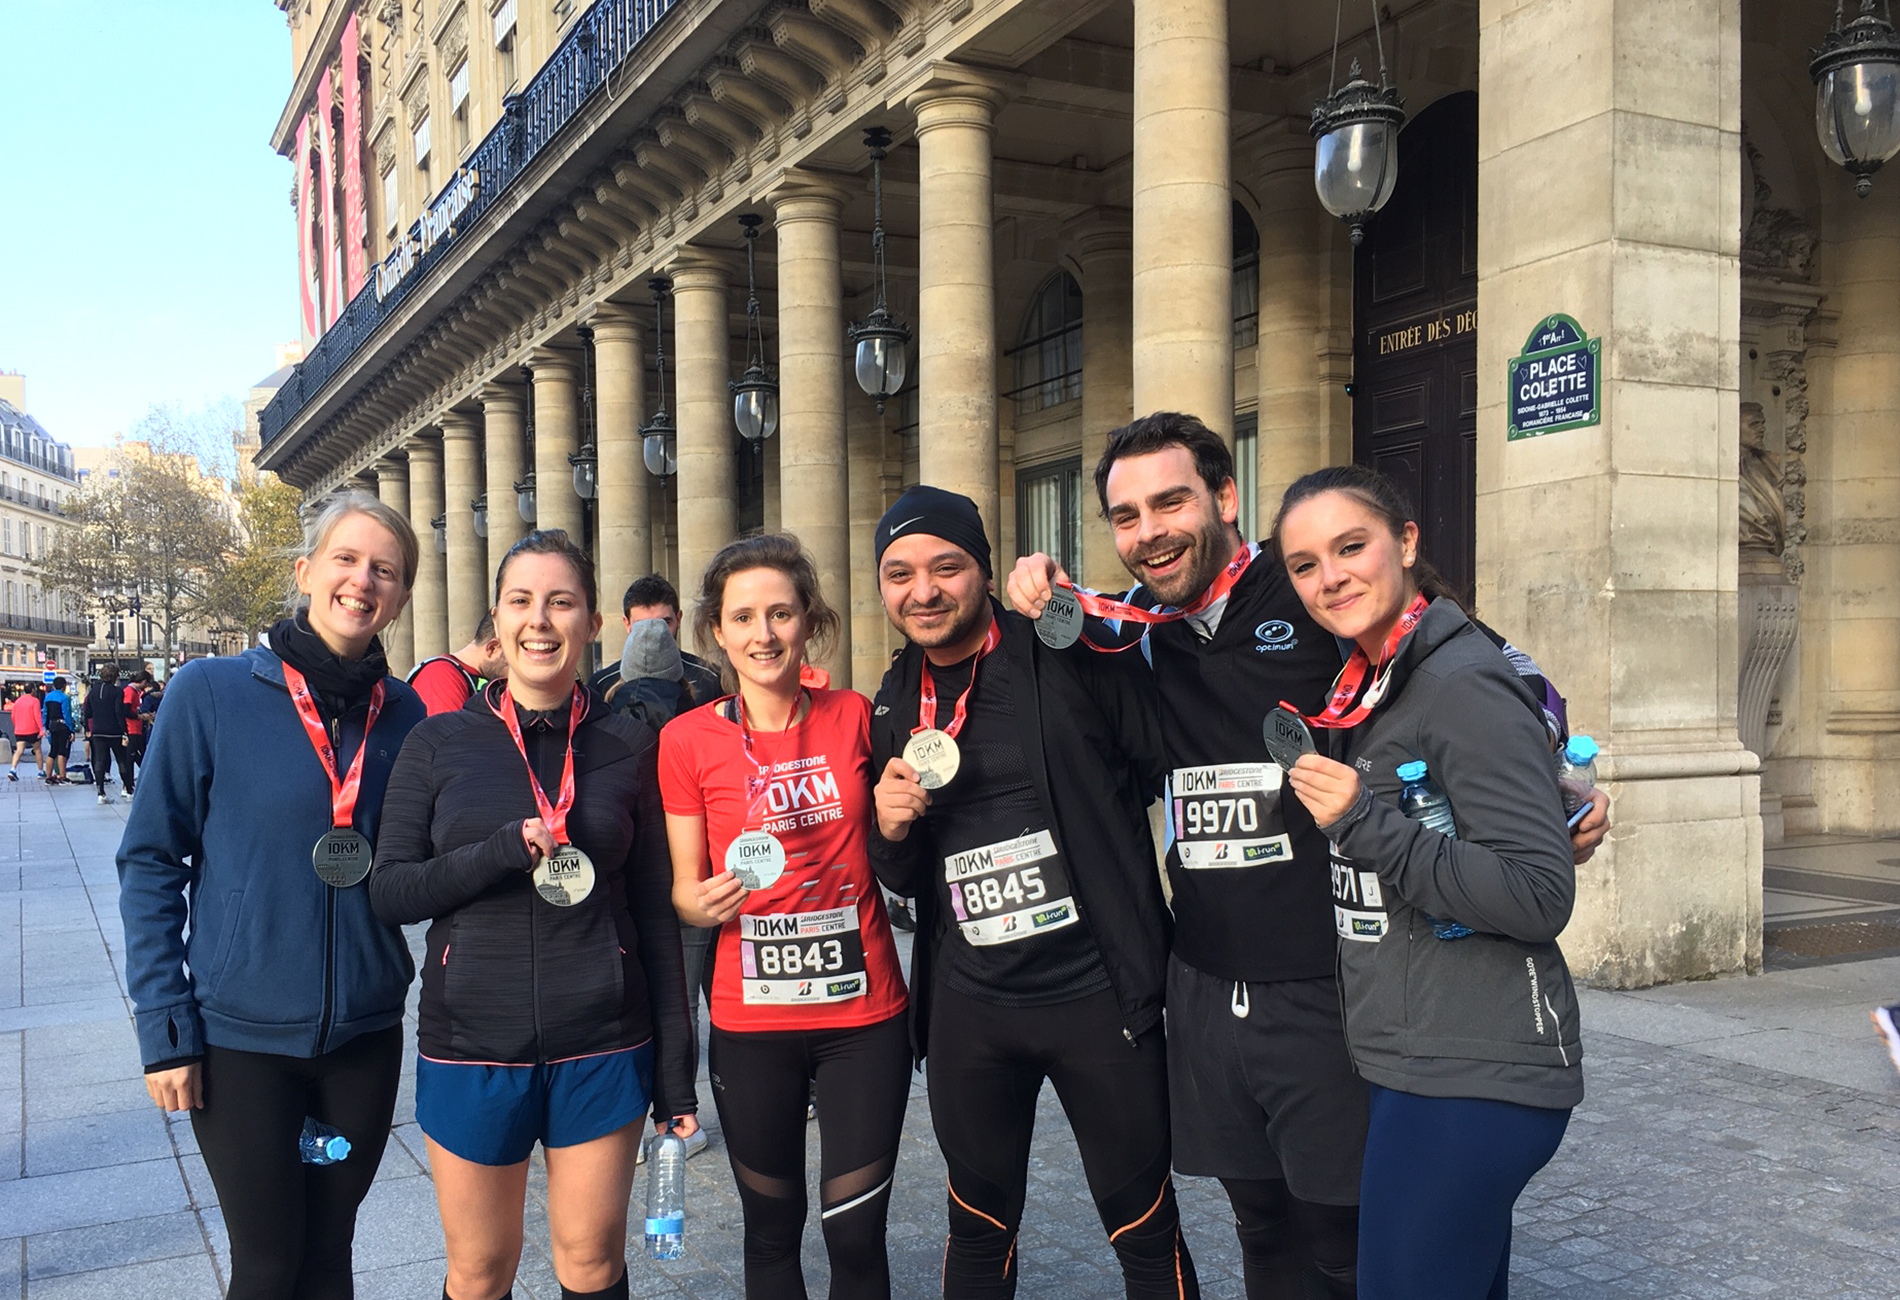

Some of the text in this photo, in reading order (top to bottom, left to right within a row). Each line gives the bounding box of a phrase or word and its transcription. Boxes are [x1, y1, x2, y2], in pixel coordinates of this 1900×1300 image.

[1380, 325, 1422, 355] ENTRÉE
[1427, 317, 1451, 342] DES
[1529, 353, 1577, 380] PLACE
[1520, 371, 1587, 401] COLETTE
[1565, 393, 1589, 405] COLETTE
[1047, 600, 1075, 619] 10KM
[1255, 643, 1294, 653] optimum
[1275, 720, 1302, 746] 10KM
[913, 739, 944, 761] 10KM
[1182, 770, 1217, 791] 10KM
[1237, 779, 1263, 788] CENTRE
[763, 771, 841, 815] 0KM
[764, 807, 844, 833] PARIS CENTRE
[1187, 798, 1258, 834] 9970
[328, 842, 359, 854] 10KM
[739, 843, 771, 858] 10KM
[1015, 848, 1042, 861] CENTRE
[547, 858, 580, 873] 10KM
[954, 849, 994, 876] 10KM
[964, 866, 1046, 914] 8845
[753, 911, 844, 936] 10KM BRIDGESTONE
[800, 922, 846, 934] PARIS CENTRE
[761, 939, 843, 975] 8843
